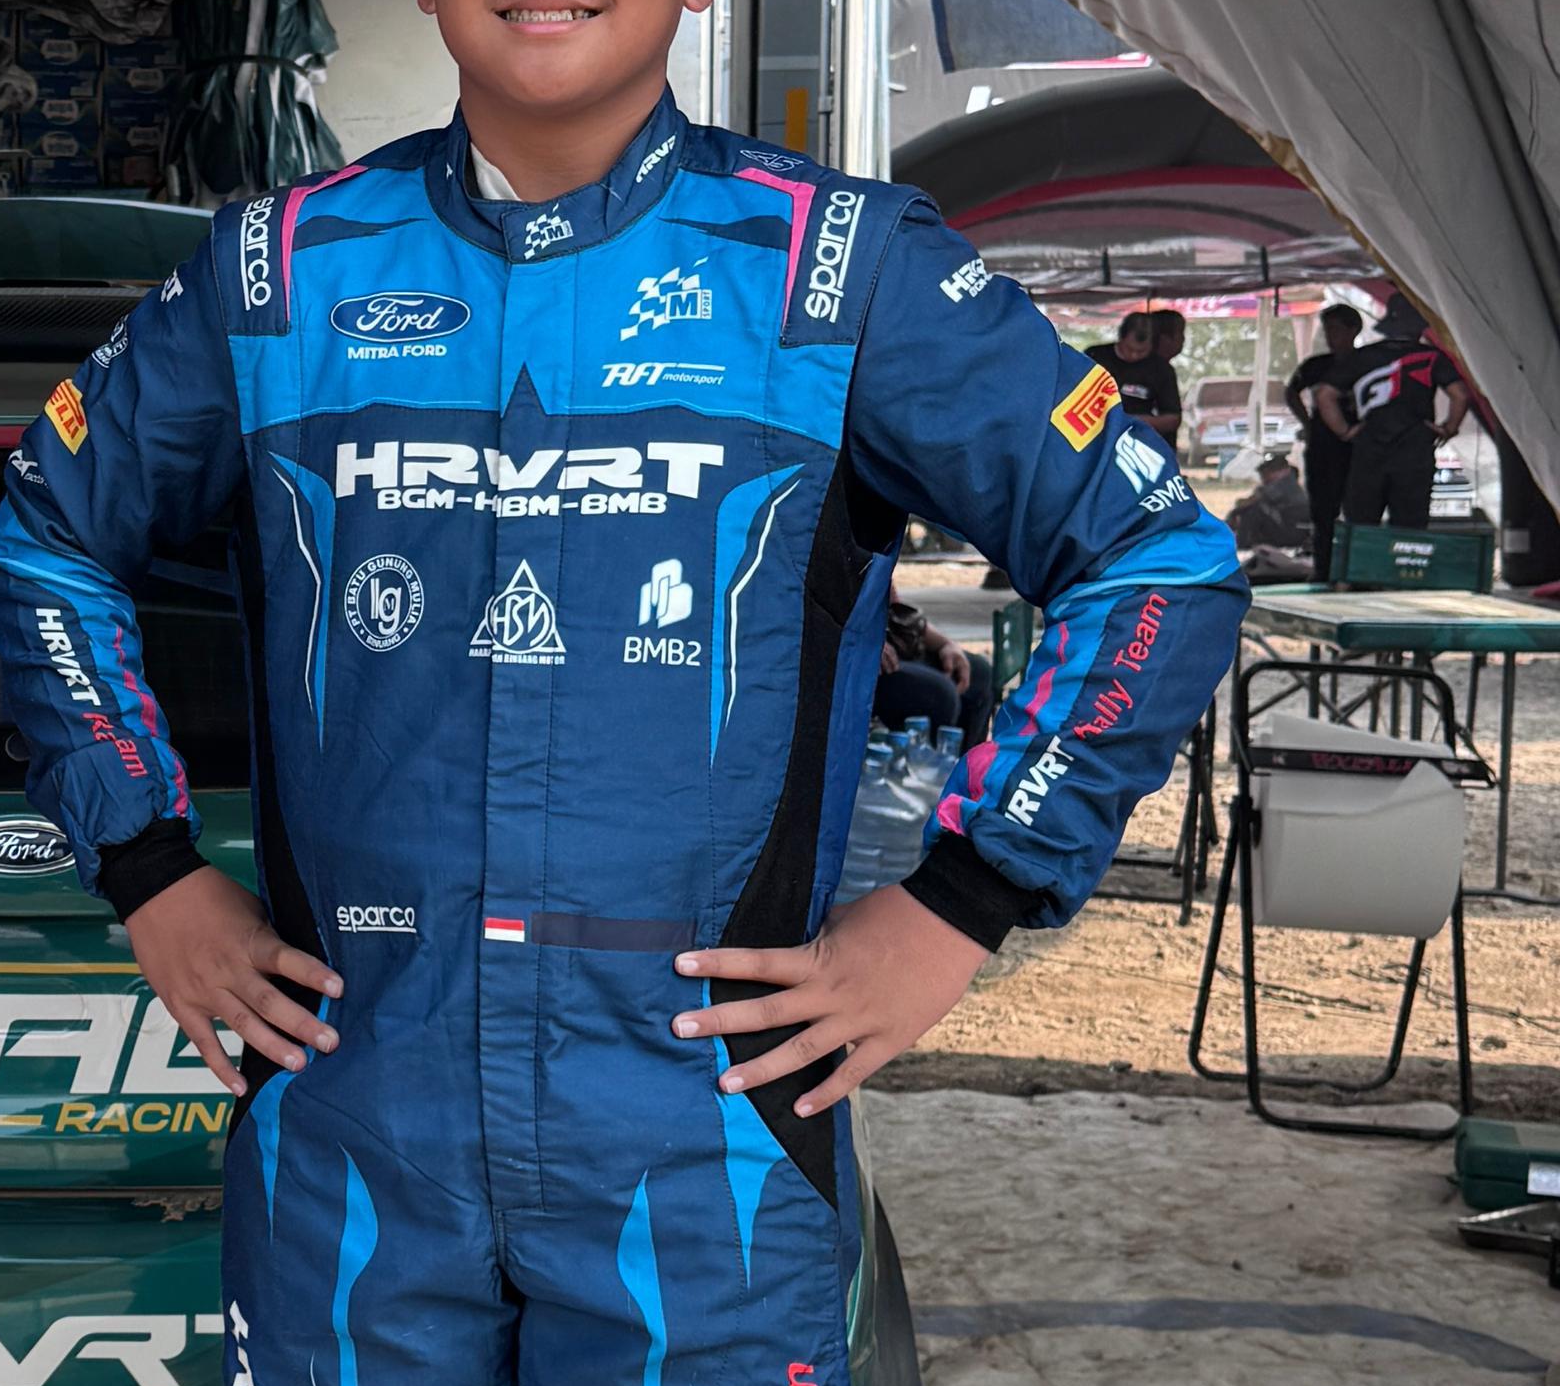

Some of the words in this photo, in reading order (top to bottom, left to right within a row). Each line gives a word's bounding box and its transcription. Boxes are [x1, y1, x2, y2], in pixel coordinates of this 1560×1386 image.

[241, 196, 276, 311] sparco
[804, 190, 866, 324] sparco
[356, 297, 444, 332] Ford
[347, 344, 399, 360] MITRA
[401, 344, 448, 358] FORD
[661, 371, 725, 386] motorsport
[335, 441, 725, 500] HRVRT
[347, 570, 367, 605] BATU
[366, 557, 414, 580] GUNUNG
[406, 580, 422, 625] MULIA
[623, 636, 702, 667] BMB2
[1113, 592, 1169, 672] Team
[35, 608, 102, 707] HRVRT
[336, 905, 417, 934] sparco
[54, 1101, 235, 1134] RACIN
